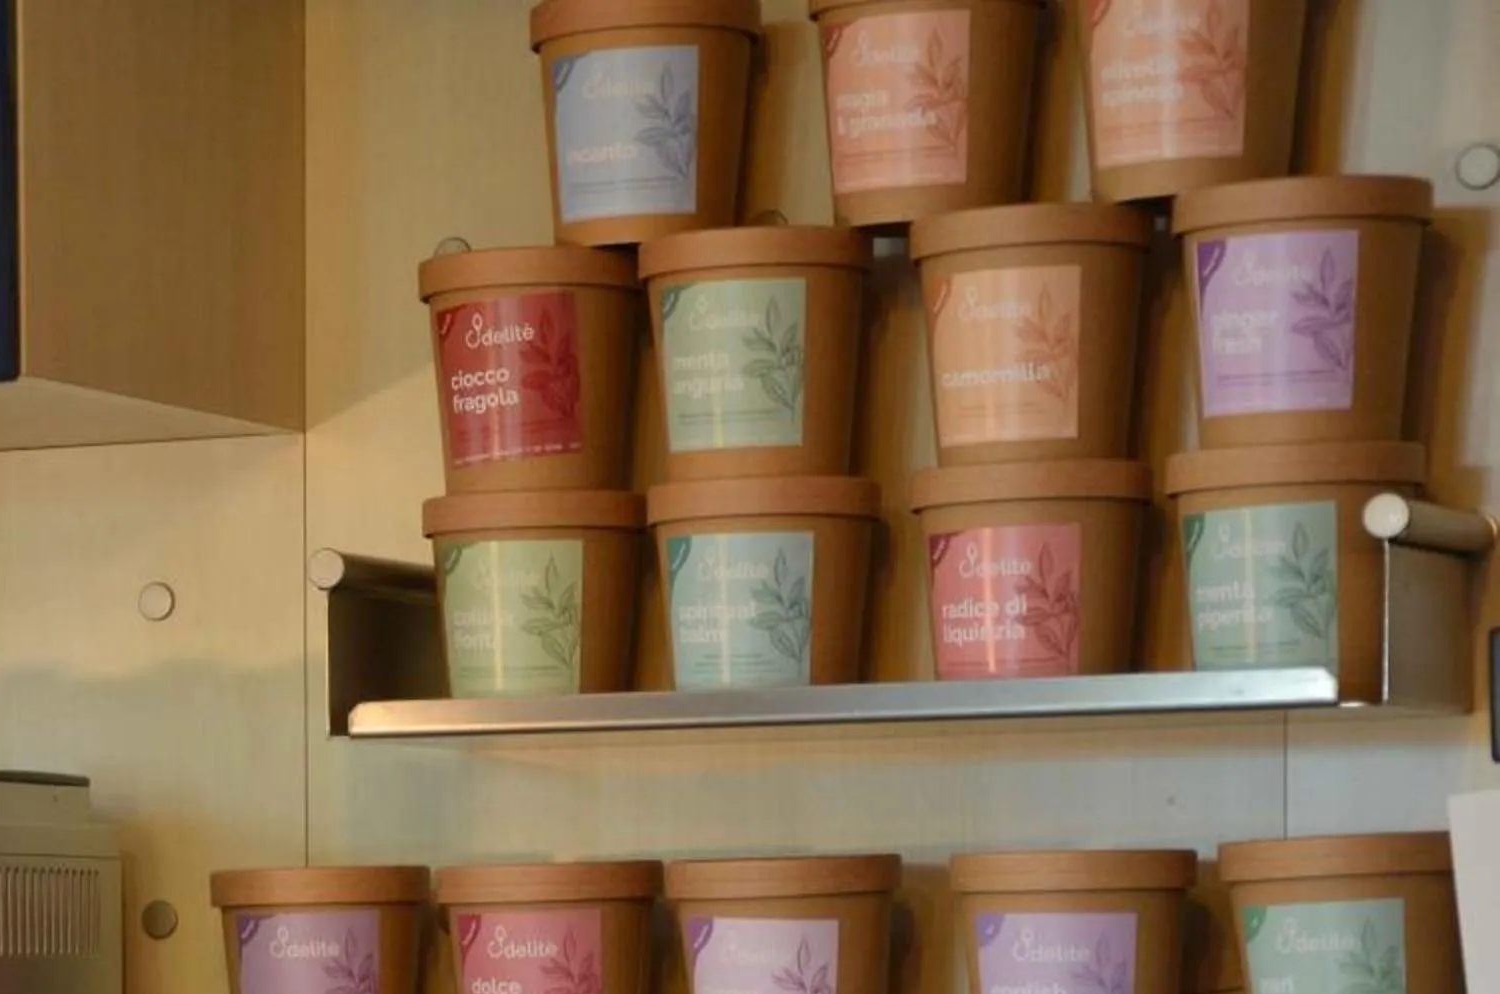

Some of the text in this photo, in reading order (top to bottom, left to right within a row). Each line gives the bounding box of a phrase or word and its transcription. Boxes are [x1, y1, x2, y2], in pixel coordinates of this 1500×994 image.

[451, 367, 510, 391] ciocco
[451, 388, 520, 415] fragola
[941, 594, 1028, 619] radice di
